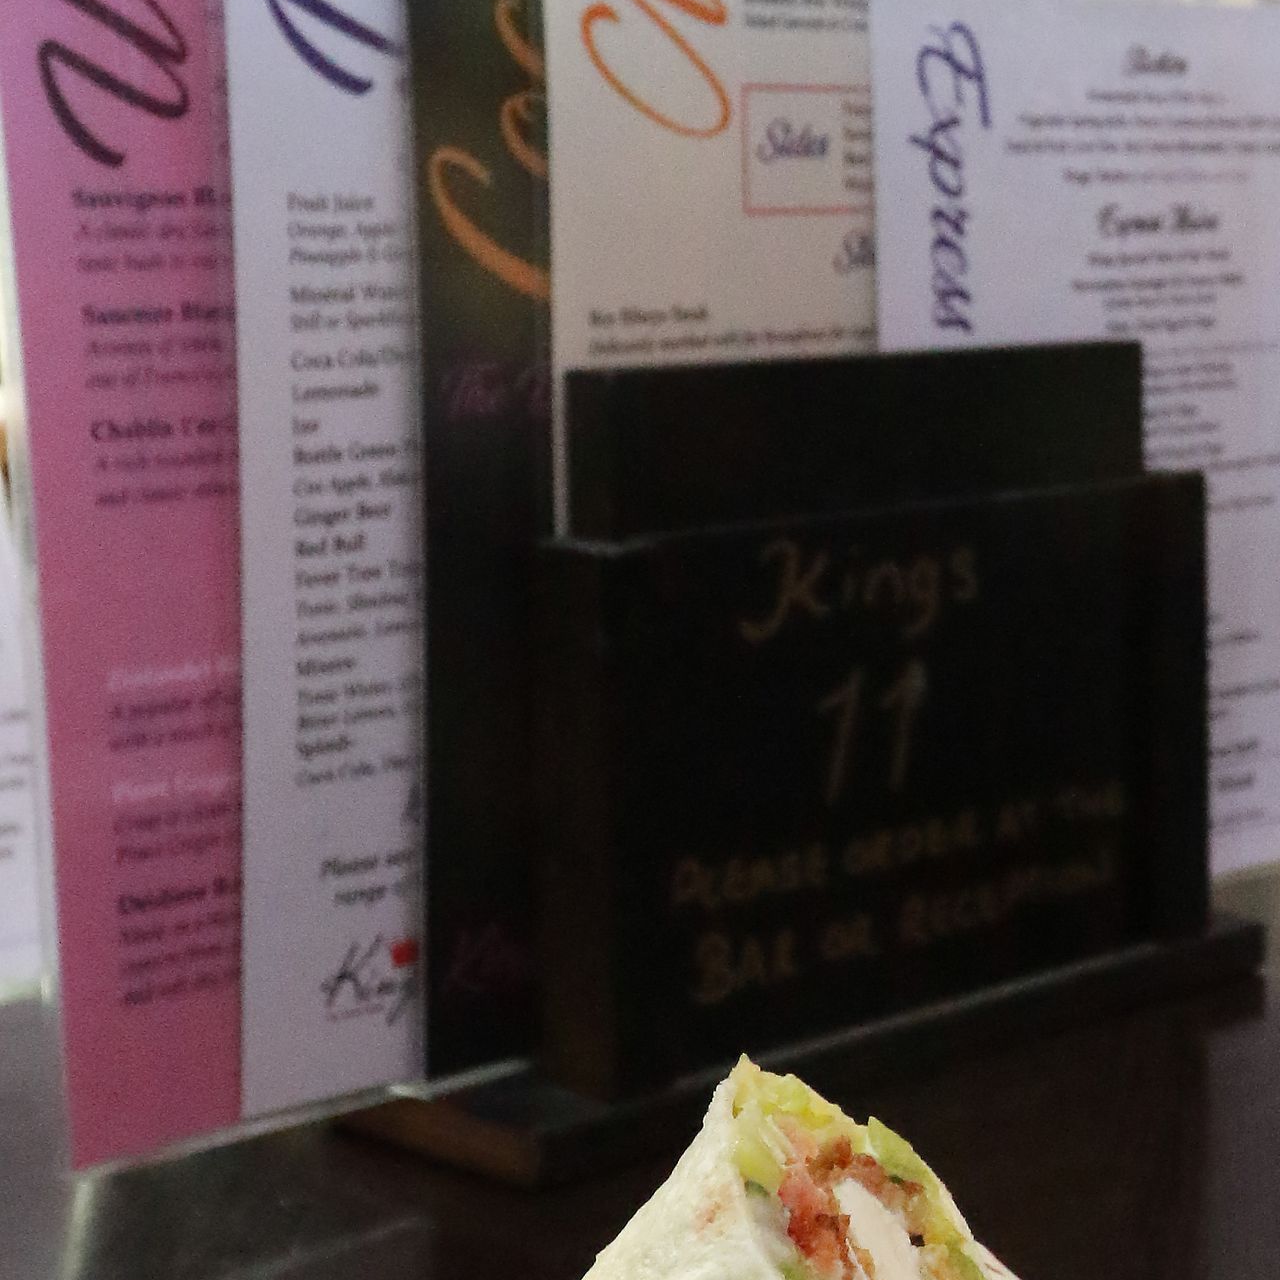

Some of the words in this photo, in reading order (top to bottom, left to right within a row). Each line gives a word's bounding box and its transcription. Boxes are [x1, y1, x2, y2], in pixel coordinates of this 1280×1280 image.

[906, 20, 994, 336] Express
[737, 537, 982, 644] Kings
[815, 659, 932, 806] 11
